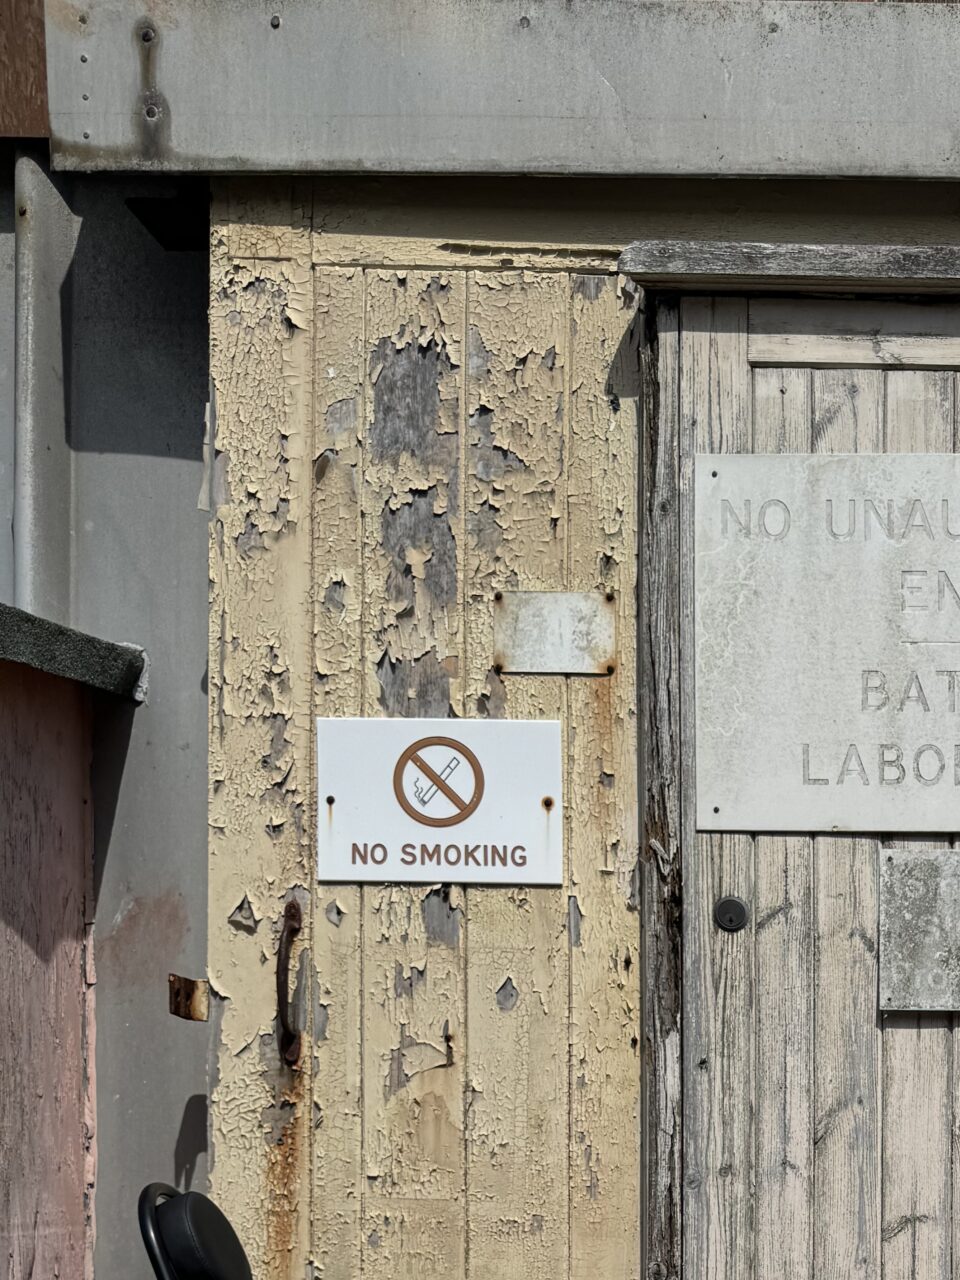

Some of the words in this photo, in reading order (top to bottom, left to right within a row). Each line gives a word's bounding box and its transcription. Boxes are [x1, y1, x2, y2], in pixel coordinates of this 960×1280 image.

[720, 499, 792, 541] NO
[351, 842, 388, 866] NO
[400, 843, 528, 868] SMOKING
